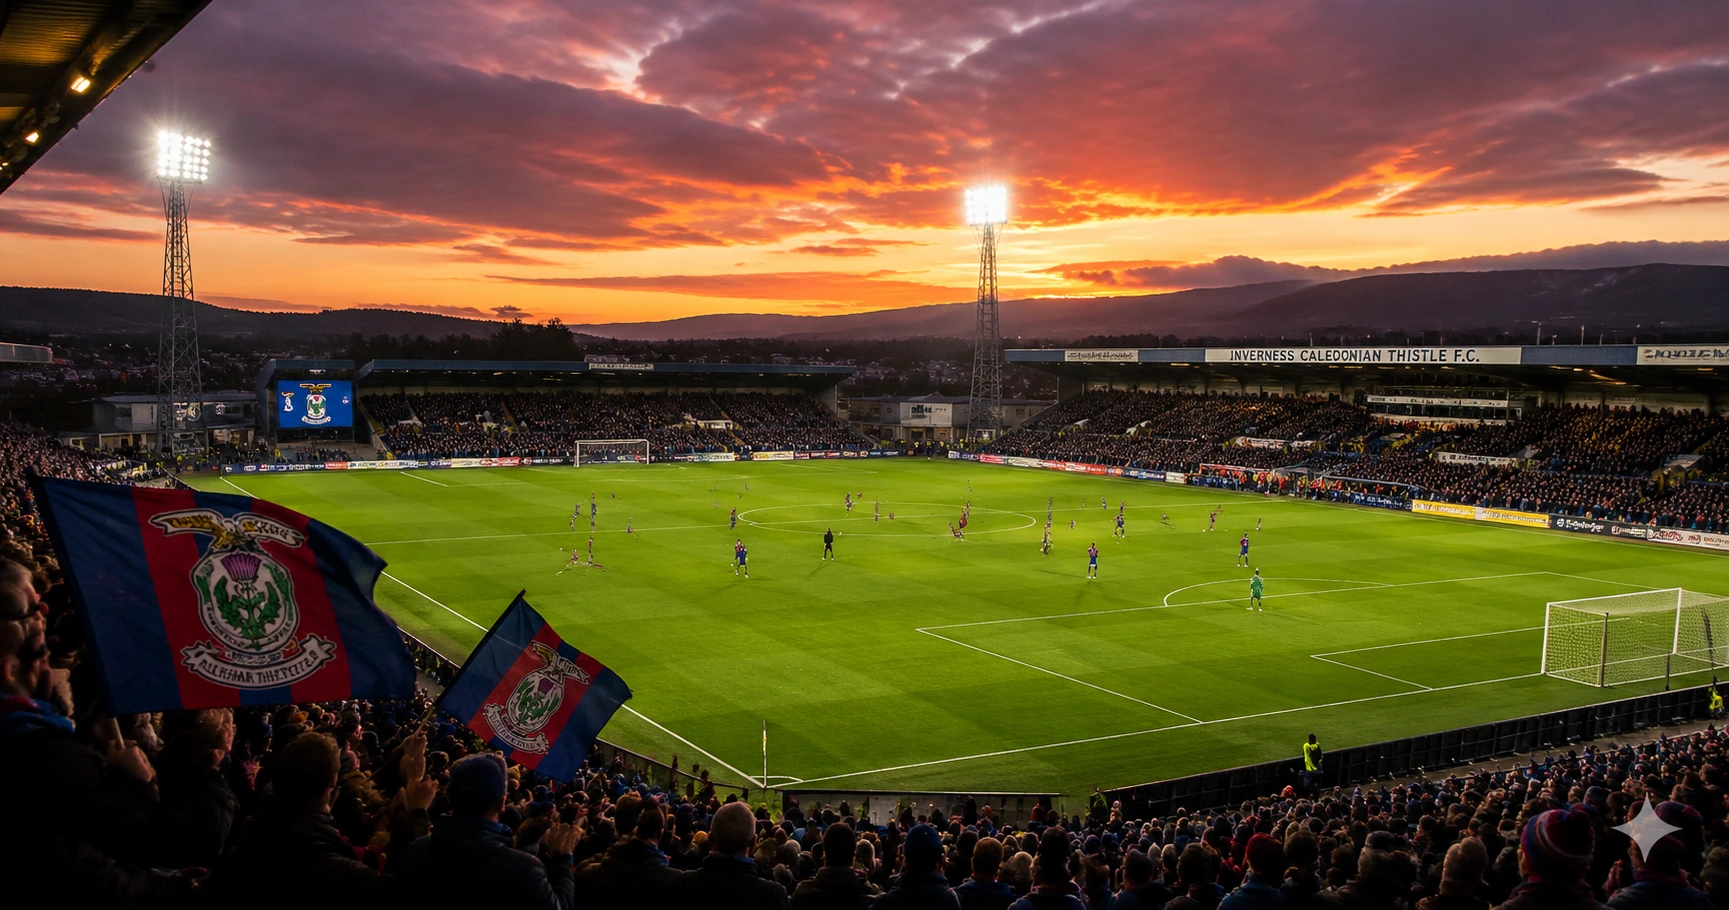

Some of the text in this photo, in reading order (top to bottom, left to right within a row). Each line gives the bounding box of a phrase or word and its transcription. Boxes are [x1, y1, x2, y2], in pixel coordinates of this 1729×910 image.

[1230, 349, 1480, 362] INVERNESS CALEDONIAN THISTLE F.C.
